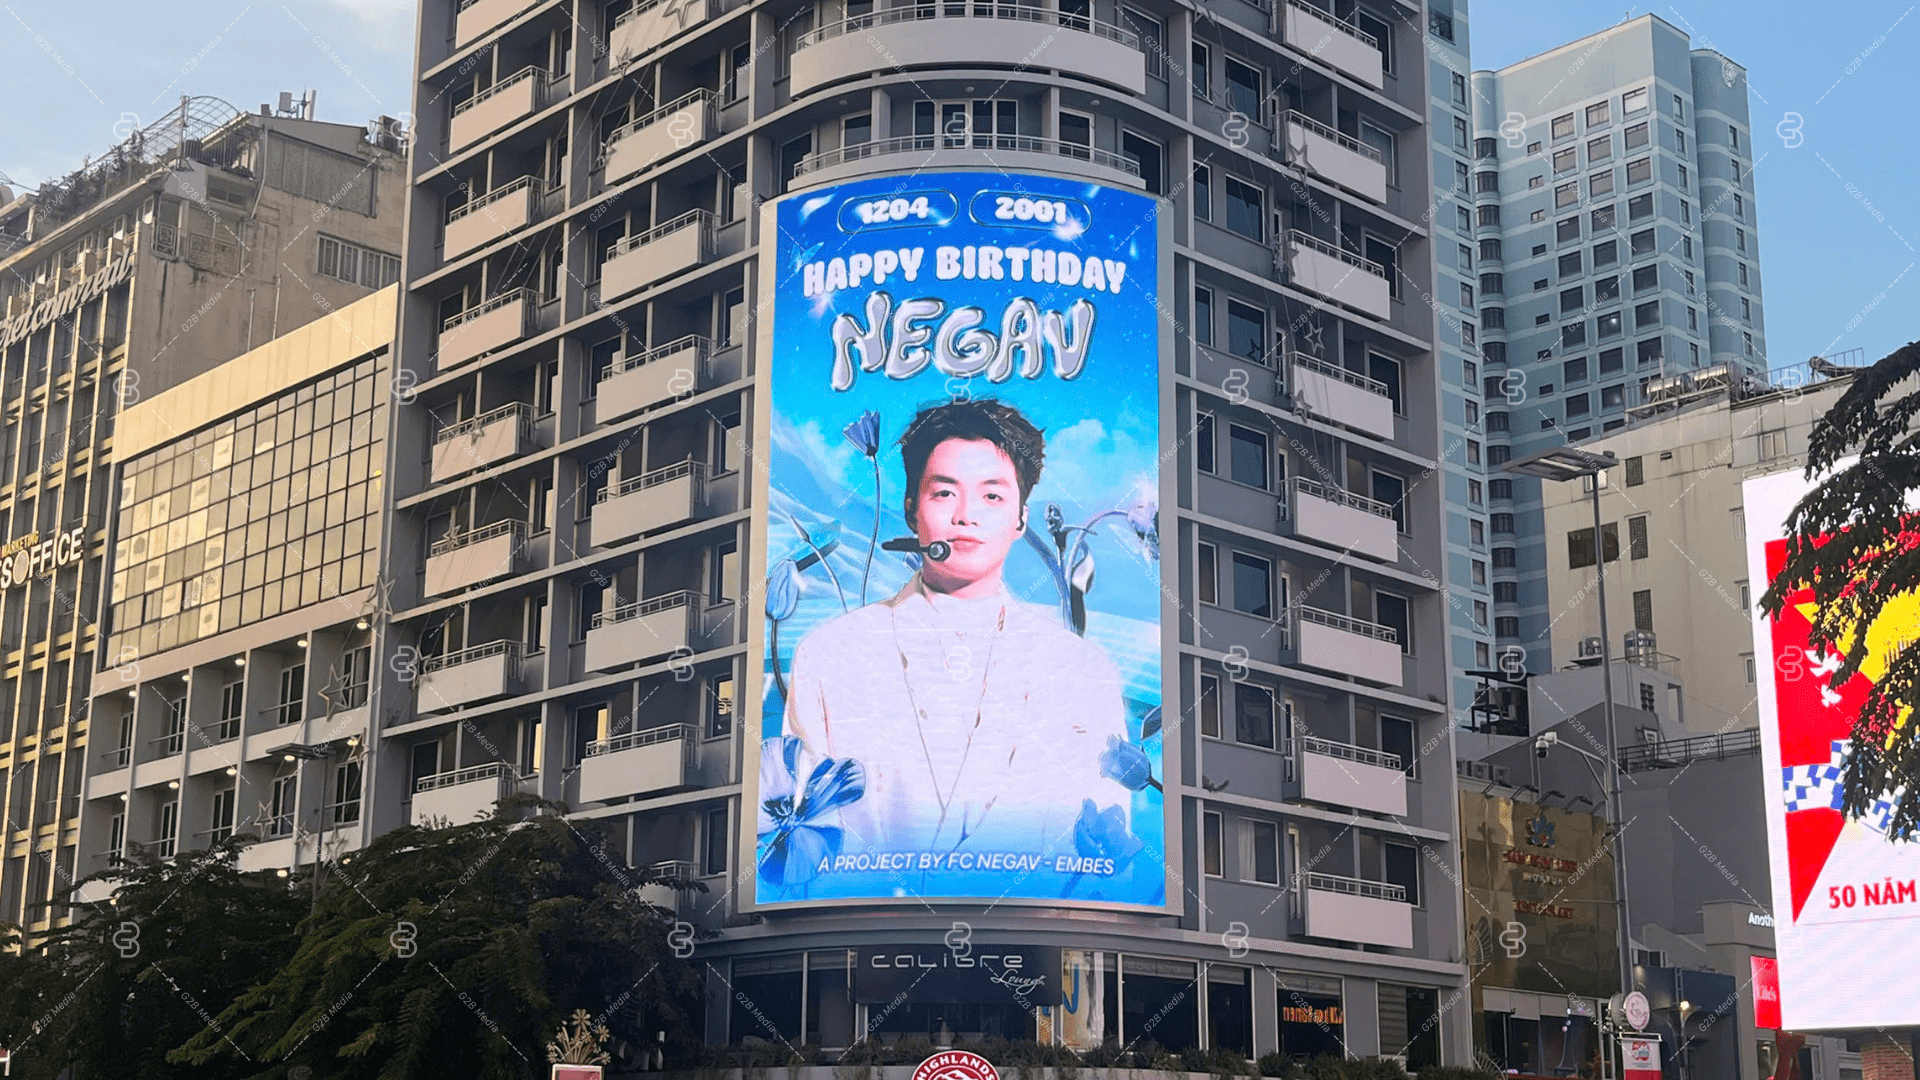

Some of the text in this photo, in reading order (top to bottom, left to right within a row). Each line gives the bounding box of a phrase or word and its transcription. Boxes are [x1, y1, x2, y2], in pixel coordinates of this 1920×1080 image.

[859, 196, 929, 224] 1204
[995, 196, 1067, 224] 2001
[803, 246, 1126, 298] HAPPY BIRTHDAY
[831, 290, 1096, 392] NEGAV
[818, 856, 829, 872] A
[834, 853, 915, 871] PROJECT
[918, 852, 943, 869] BY
[947, 852, 974, 869] FC
[976, 853, 1041, 870] NEGAV
[1055, 855, 1114, 875] EMBES
[1829, 876, 1917, 909] 50 NĂM
